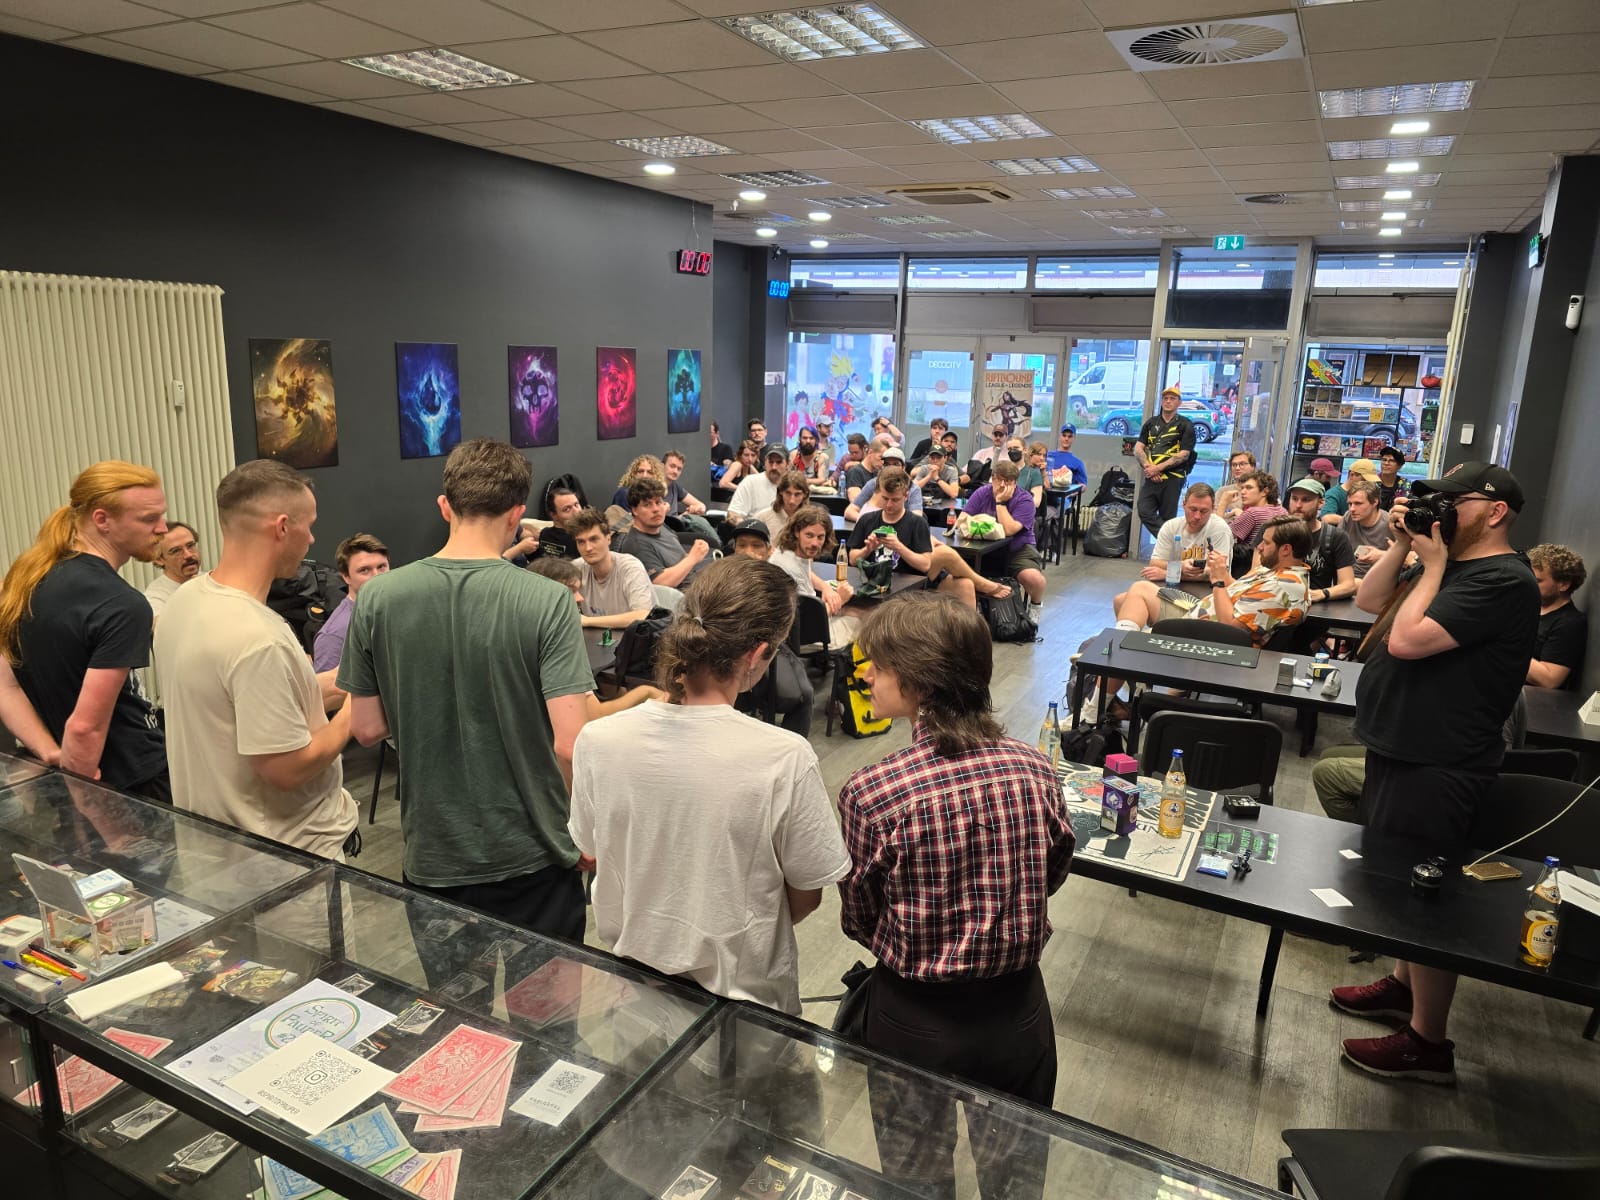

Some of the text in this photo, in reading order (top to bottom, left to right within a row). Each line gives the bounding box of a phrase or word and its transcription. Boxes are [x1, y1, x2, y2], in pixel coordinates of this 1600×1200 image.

[985, 371, 1033, 384] RIFTBOUND
[1147, 638, 1236, 656] PAUPER
[1160, 644, 1219, 657] PAPER
